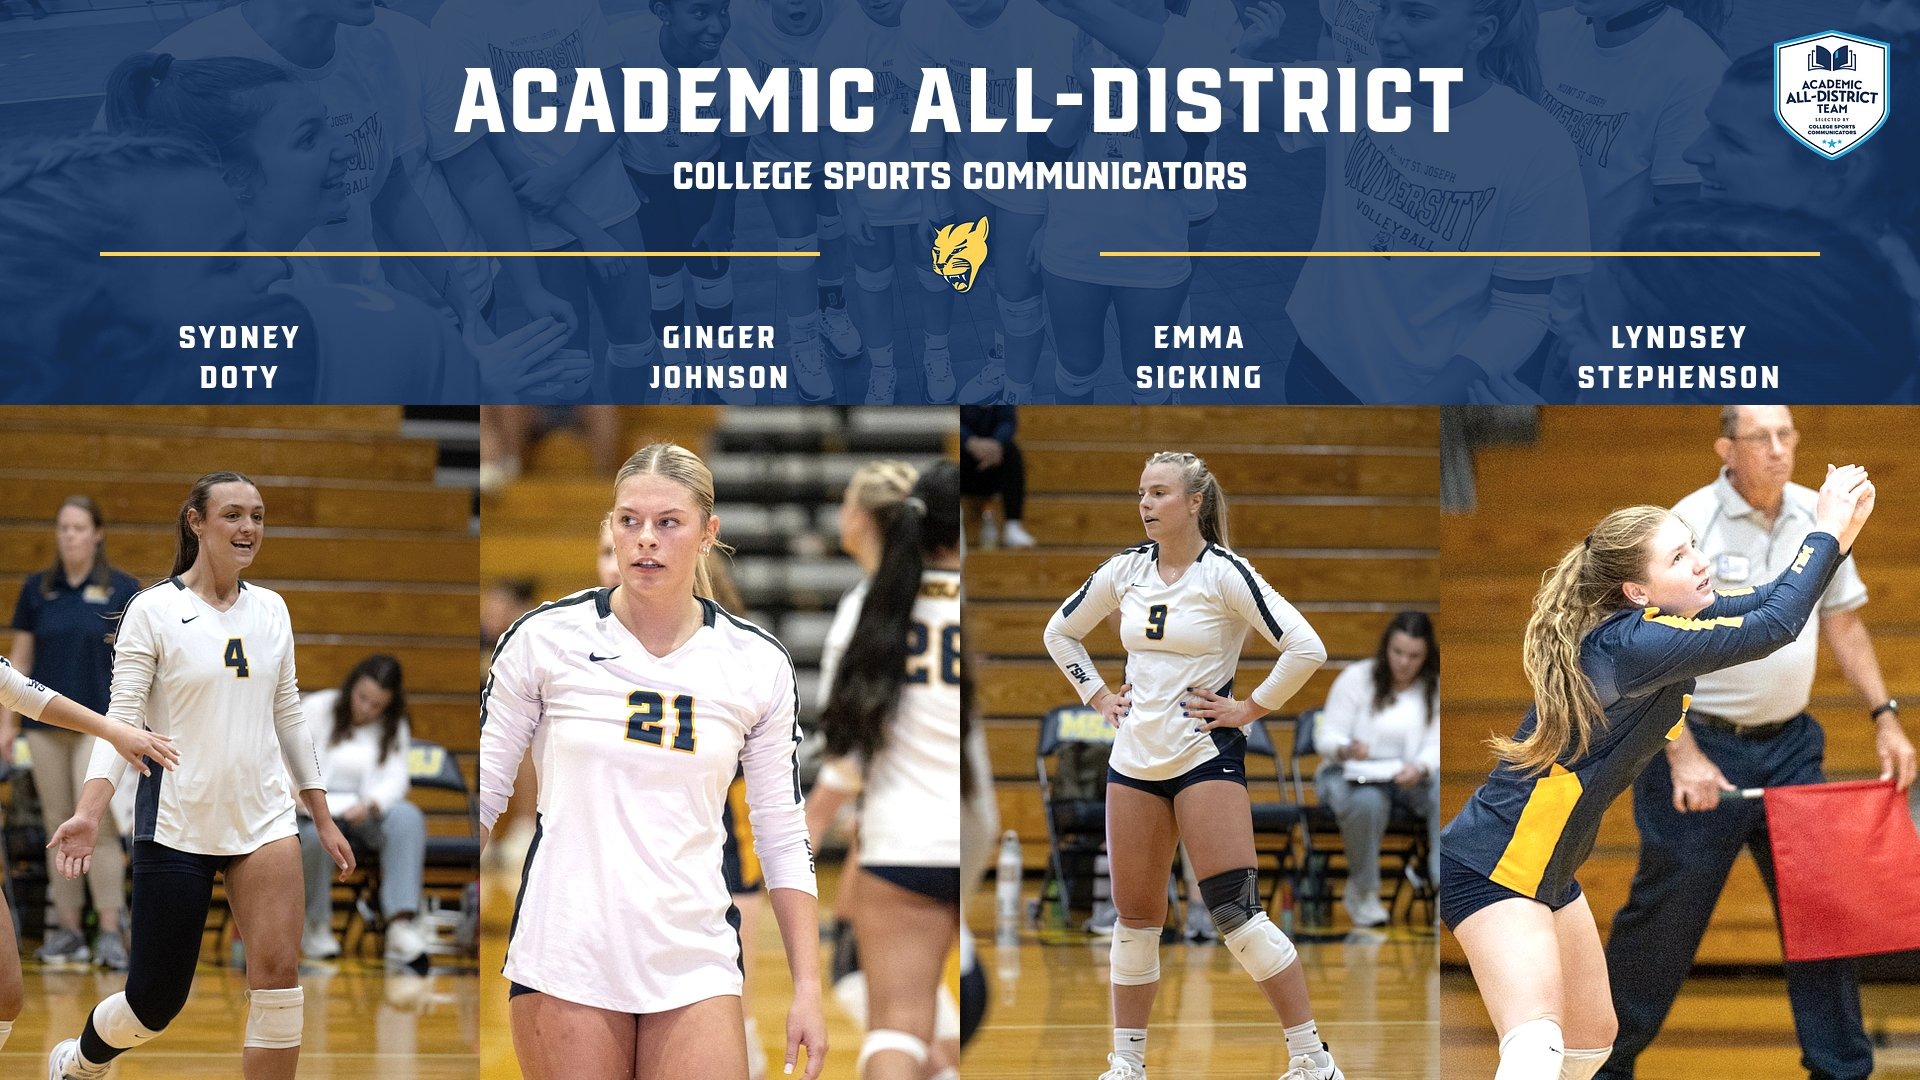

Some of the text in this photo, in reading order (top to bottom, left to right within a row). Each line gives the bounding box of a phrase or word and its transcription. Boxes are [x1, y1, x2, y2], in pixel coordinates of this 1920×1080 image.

[1356, 198, 1436, 252] VOLLEYBALL
[1145, 604, 1168, 641] 9
[224, 637, 249, 679] 4
[1066, 663, 1090, 684] MSJ
[625, 690, 697, 755] 21
